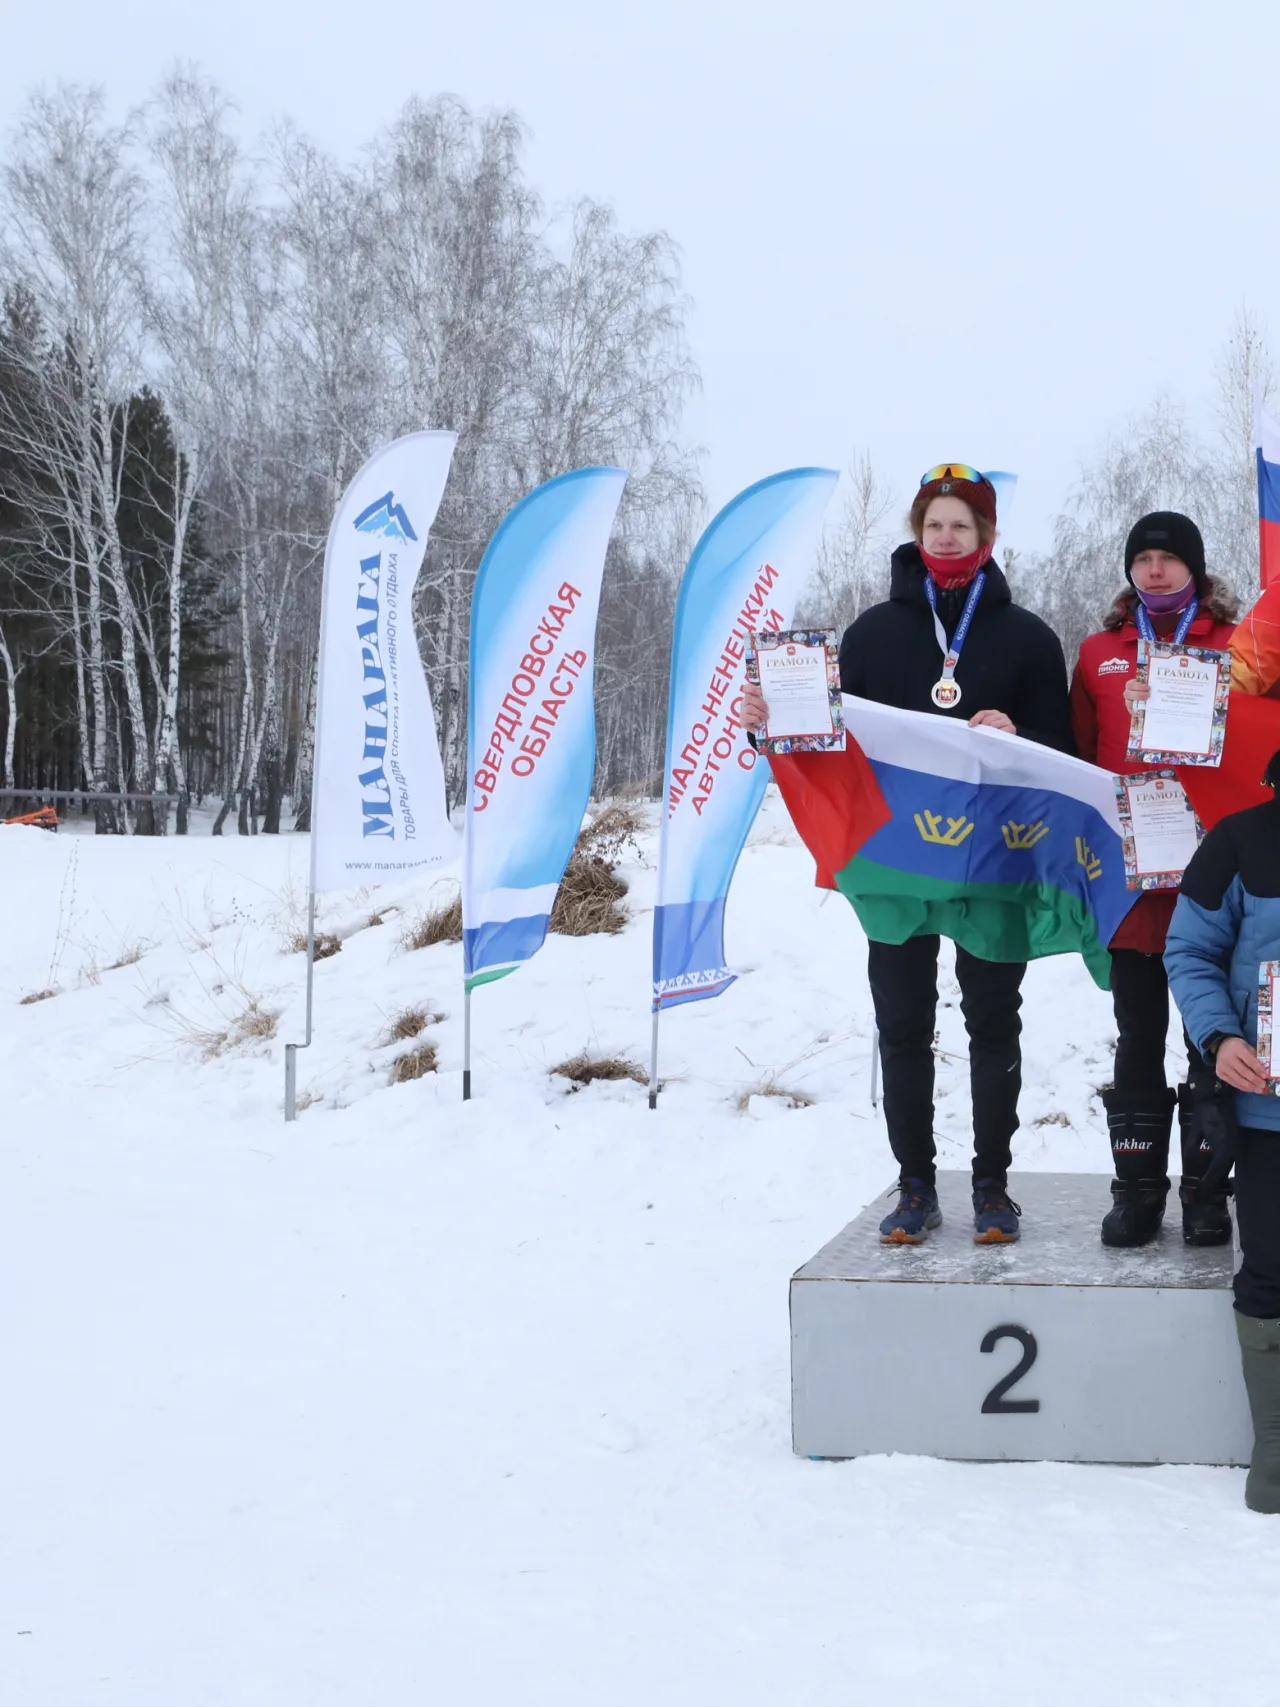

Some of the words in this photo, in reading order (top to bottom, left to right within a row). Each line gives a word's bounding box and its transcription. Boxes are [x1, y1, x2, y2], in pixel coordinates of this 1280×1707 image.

[386, 610, 399, 688] АКТИВНОГО
[766, 656, 818, 667] ГРАМОТА
[1098, 664, 1130, 673] ПИОНЕР
[668, 564, 779, 819] МАЛО-НЕНЕЦКИЙ
[1157, 667, 1209, 681] ГРАМОТА
[356, 551, 395, 841] МАНАРАГА
[392, 691, 400, 702] И
[511, 649, 587, 777] ОБЛАСТЬ
[391, 705, 400, 757] СПОРТА
[390, 760, 407, 787] ДЛЯ
[399, 787, 417, 841] ТОВАРЫ
[1136, 791, 1186, 802] ГРАМОТА
[1113, 1138, 1153, 1150] Arkhar
[979, 1325, 1040, 1413] 2
